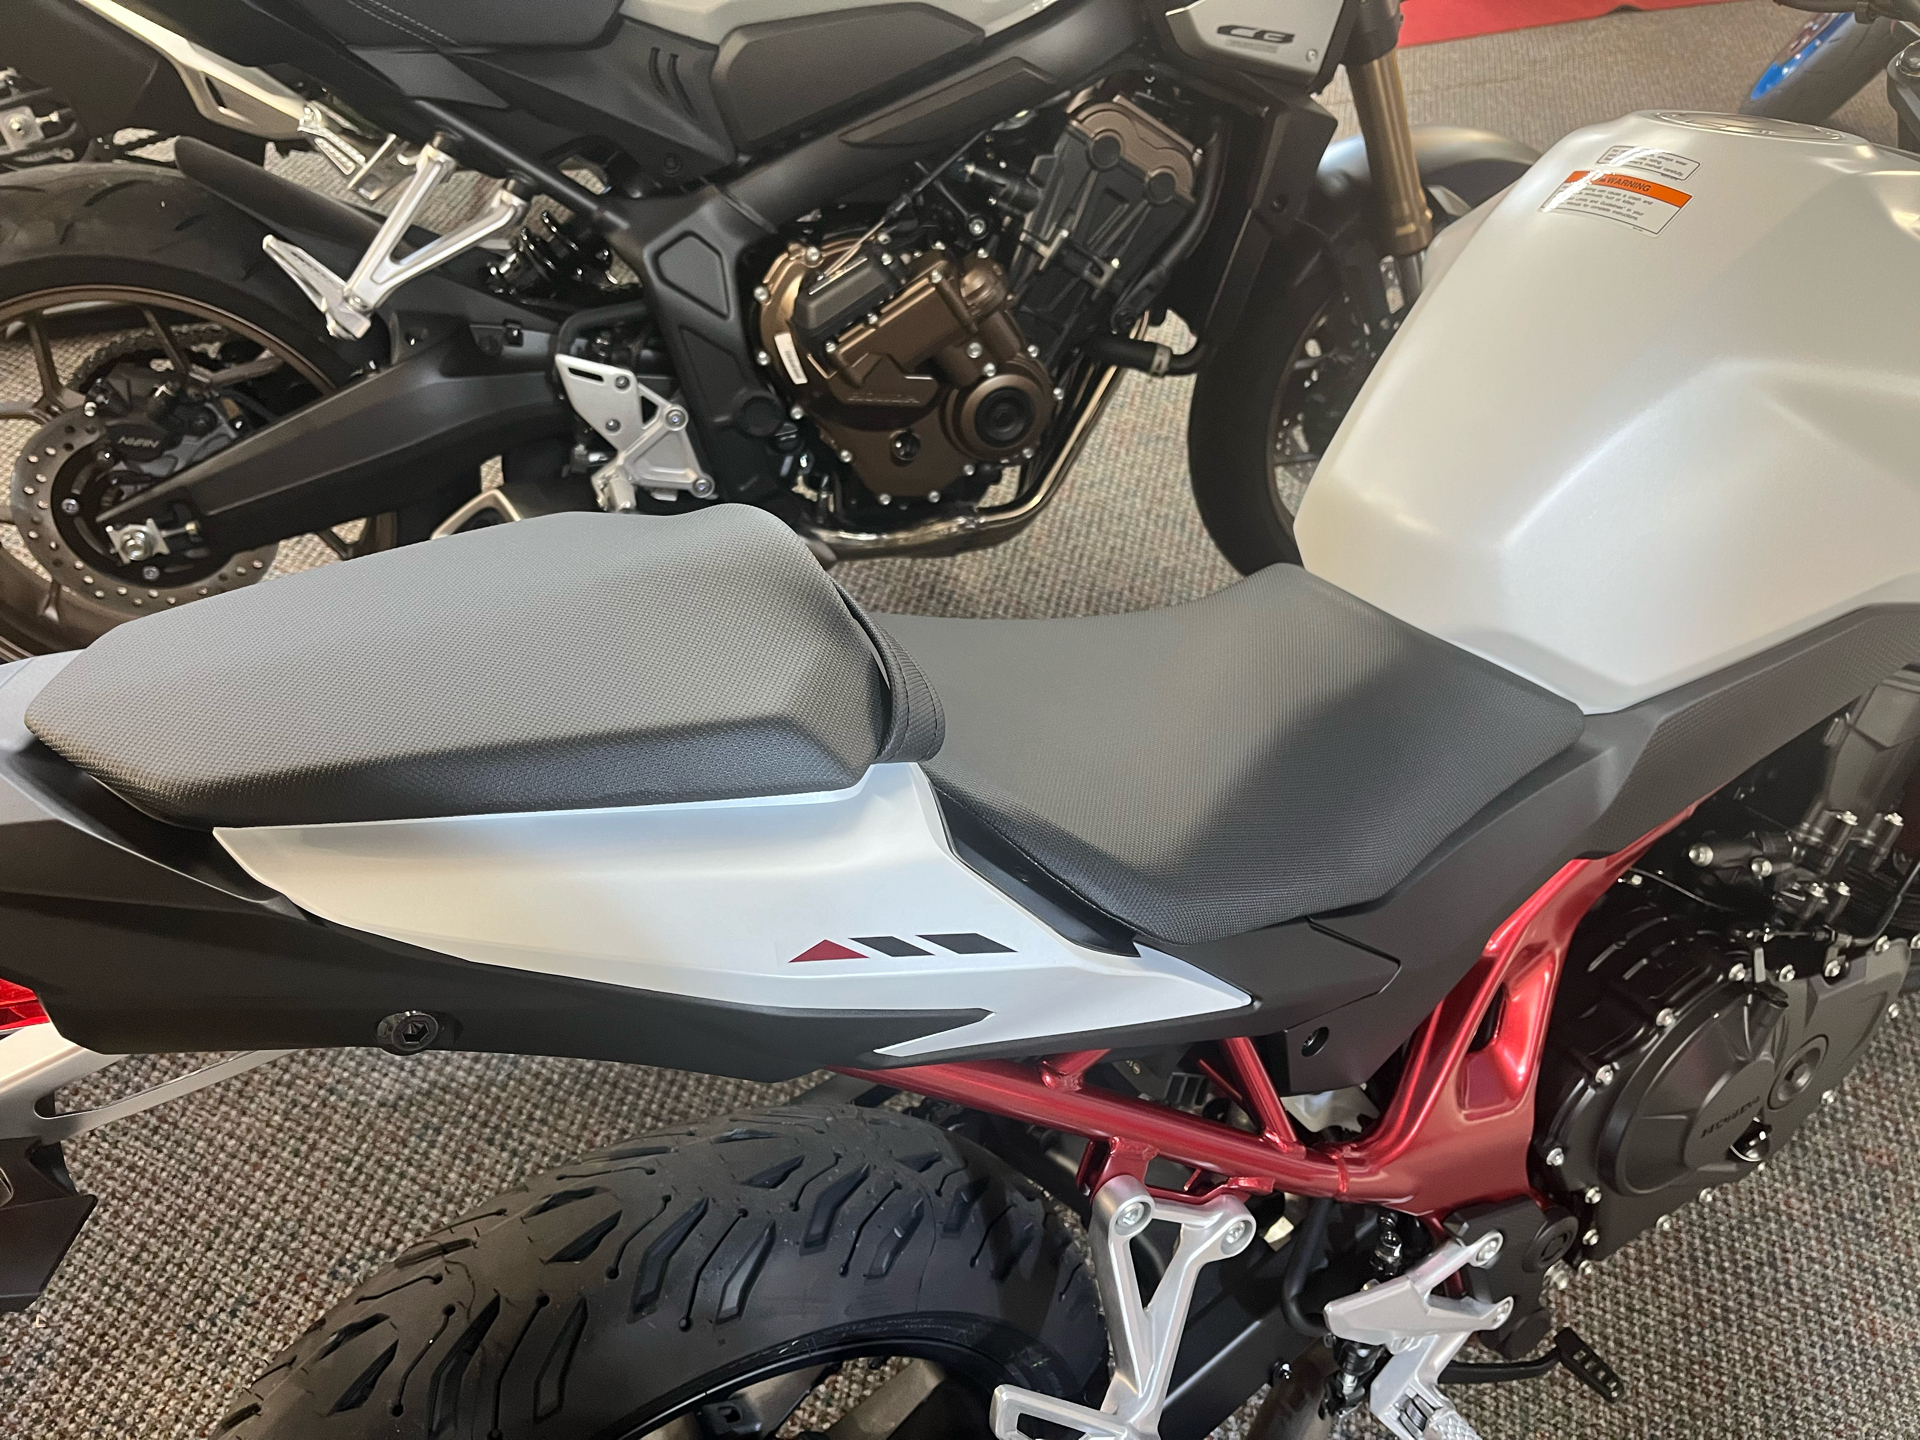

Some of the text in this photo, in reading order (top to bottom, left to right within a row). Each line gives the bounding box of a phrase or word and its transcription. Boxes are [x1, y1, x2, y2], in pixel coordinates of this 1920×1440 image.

[1217, 25, 1295, 44] CB
[1657, 154, 1674, 162] always
[1606, 177, 1652, 192] WARNING
